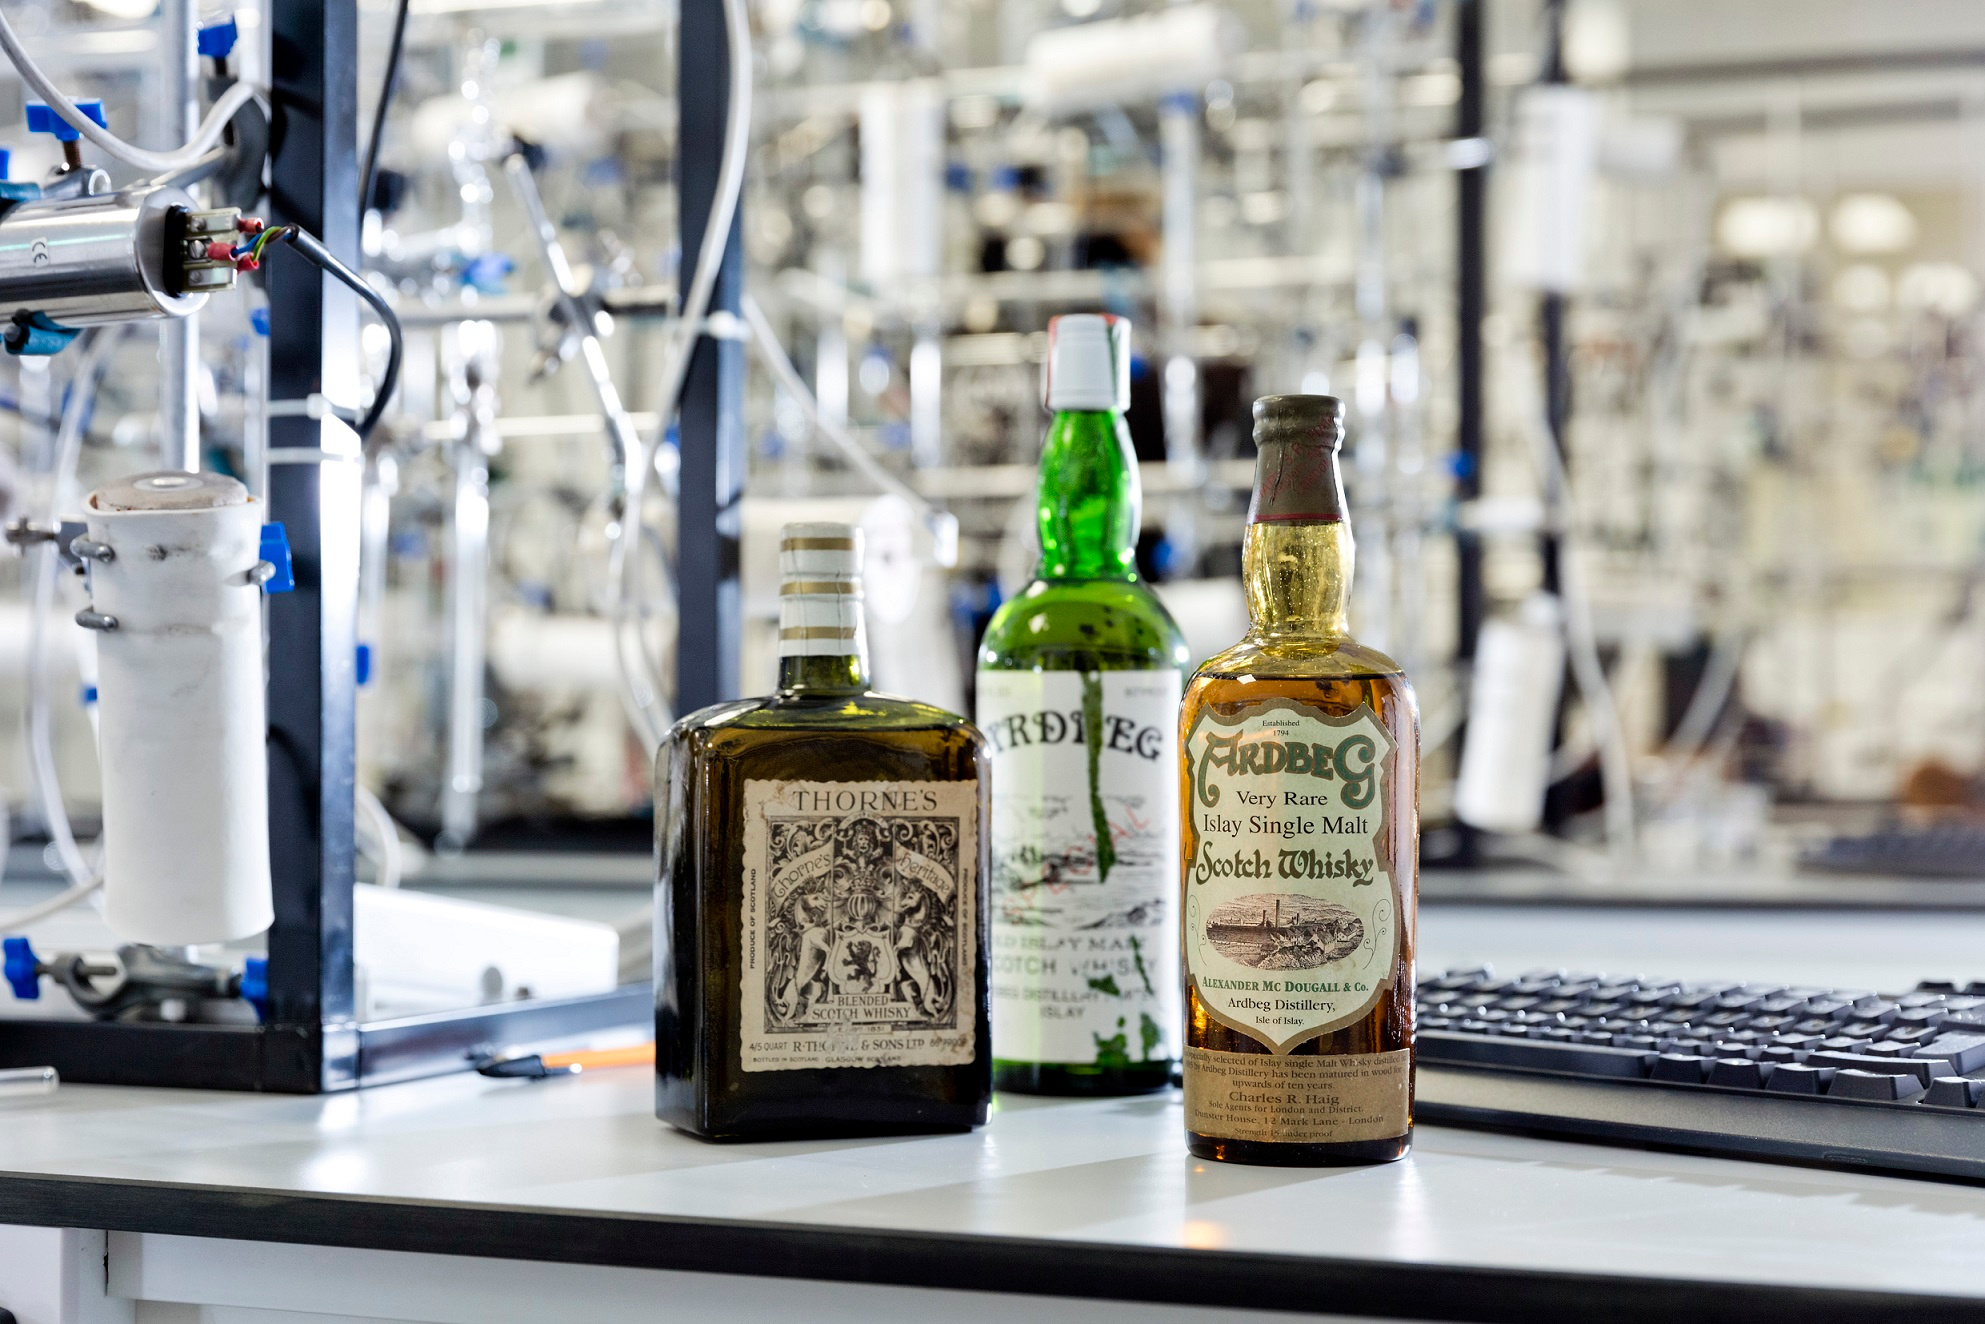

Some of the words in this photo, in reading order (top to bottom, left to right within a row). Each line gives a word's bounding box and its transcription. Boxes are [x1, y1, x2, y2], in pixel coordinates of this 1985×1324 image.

[1262, 719, 1300, 727] Established
[1273, 729, 1289, 737] 1794
[1197, 728, 1376, 810] ARDBEG
[793, 790, 938, 812] THORNE'S
[1236, 790, 1277, 809] Very
[1283, 791, 1328, 806] Rare
[1203, 813, 1243, 838] Islay
[1249, 815, 1315, 839] Single
[1322, 816, 1368, 834] Malt
[1195, 840, 1272, 886] Scotch
[1277, 848, 1374, 888] Whisky
[773, 853, 831, 898] Thorne's
[750, 916, 756, 927] OF
[1202, 976, 1260, 992] ALEXANDER
[1284, 981, 1341, 993] DOUGALL
[1343, 982, 1352, 993] &
[837, 995, 889, 1007] BLENDED
[1228, 997, 1271, 1012] Ardbeg
[1275, 998, 1336, 1014] Distillery,
[812, 1008, 858, 1020] SCOTCH
[863, 1006, 911, 1019] WHISKY
[1255, 1015, 1271, 1024] Isle
[1272, 1016, 1282, 1025] of
[1283, 1016, 1305, 1027] Islay.
[749, 1042, 763, 1052] 4/5
[763, 1041, 788, 1052] QUART
[861, 1039, 870, 1051] &
[872, 1039, 904, 1051] SONS
[1213, 1055, 1246, 1066] selected
[1248, 1057, 1259, 1066] of
[1260, 1058, 1282, 1069] Islay
[1284, 1059, 1314, 1070] single
[1316, 1059, 1337, 1069] Malt
[1339, 1058, 1372, 1070] Whisky
[1202, 1064, 1227, 1077] Ardbeg
[1228, 1067, 1269, 1079] Distillery
[1271, 1069, 1289, 1079] has
[1291, 1069, 1316, 1079] been
[1319, 1069, 1359, 1079] matured
[1361, 1069, 1369, 1077] in
[1371, 1066, 1392, 1076] wood
[1393, 1065, 1402, 1074] for
[1232, 1079, 1272, 1090] upwards
[1274, 1080, 1286, 1090] of
[1287, 1081, 1304, 1090] ten
[1306, 1082, 1335, 1092] years.
[1229, 1091, 1282, 1104] Charles
[1287, 1094, 1302, 1104] R.
[1305, 1094, 1341, 1106] Haig
[1208, 1100, 1223, 1109] Sole
[1225, 1103, 1252, 1112] Agents
[1254, 1105, 1268, 1113] for
[1270, 1105, 1305, 1114] London
[1308, 1106, 1326, 1114] and
[1328, 1105, 1364, 1114] District.
[1194, 1108, 1224, 1121] Dunster
[1264, 1117, 1277, 1126] 12
[1280, 1117, 1309, 1126] Mark
[1312, 1117, 1339, 1126] Lane
[1348, 1115, 1384, 1125] London
[1234, 1127, 1268, 1138] Strength
[1270, 1129, 1280, 1137] 15
[1309, 1130, 1334, 1139] proof
